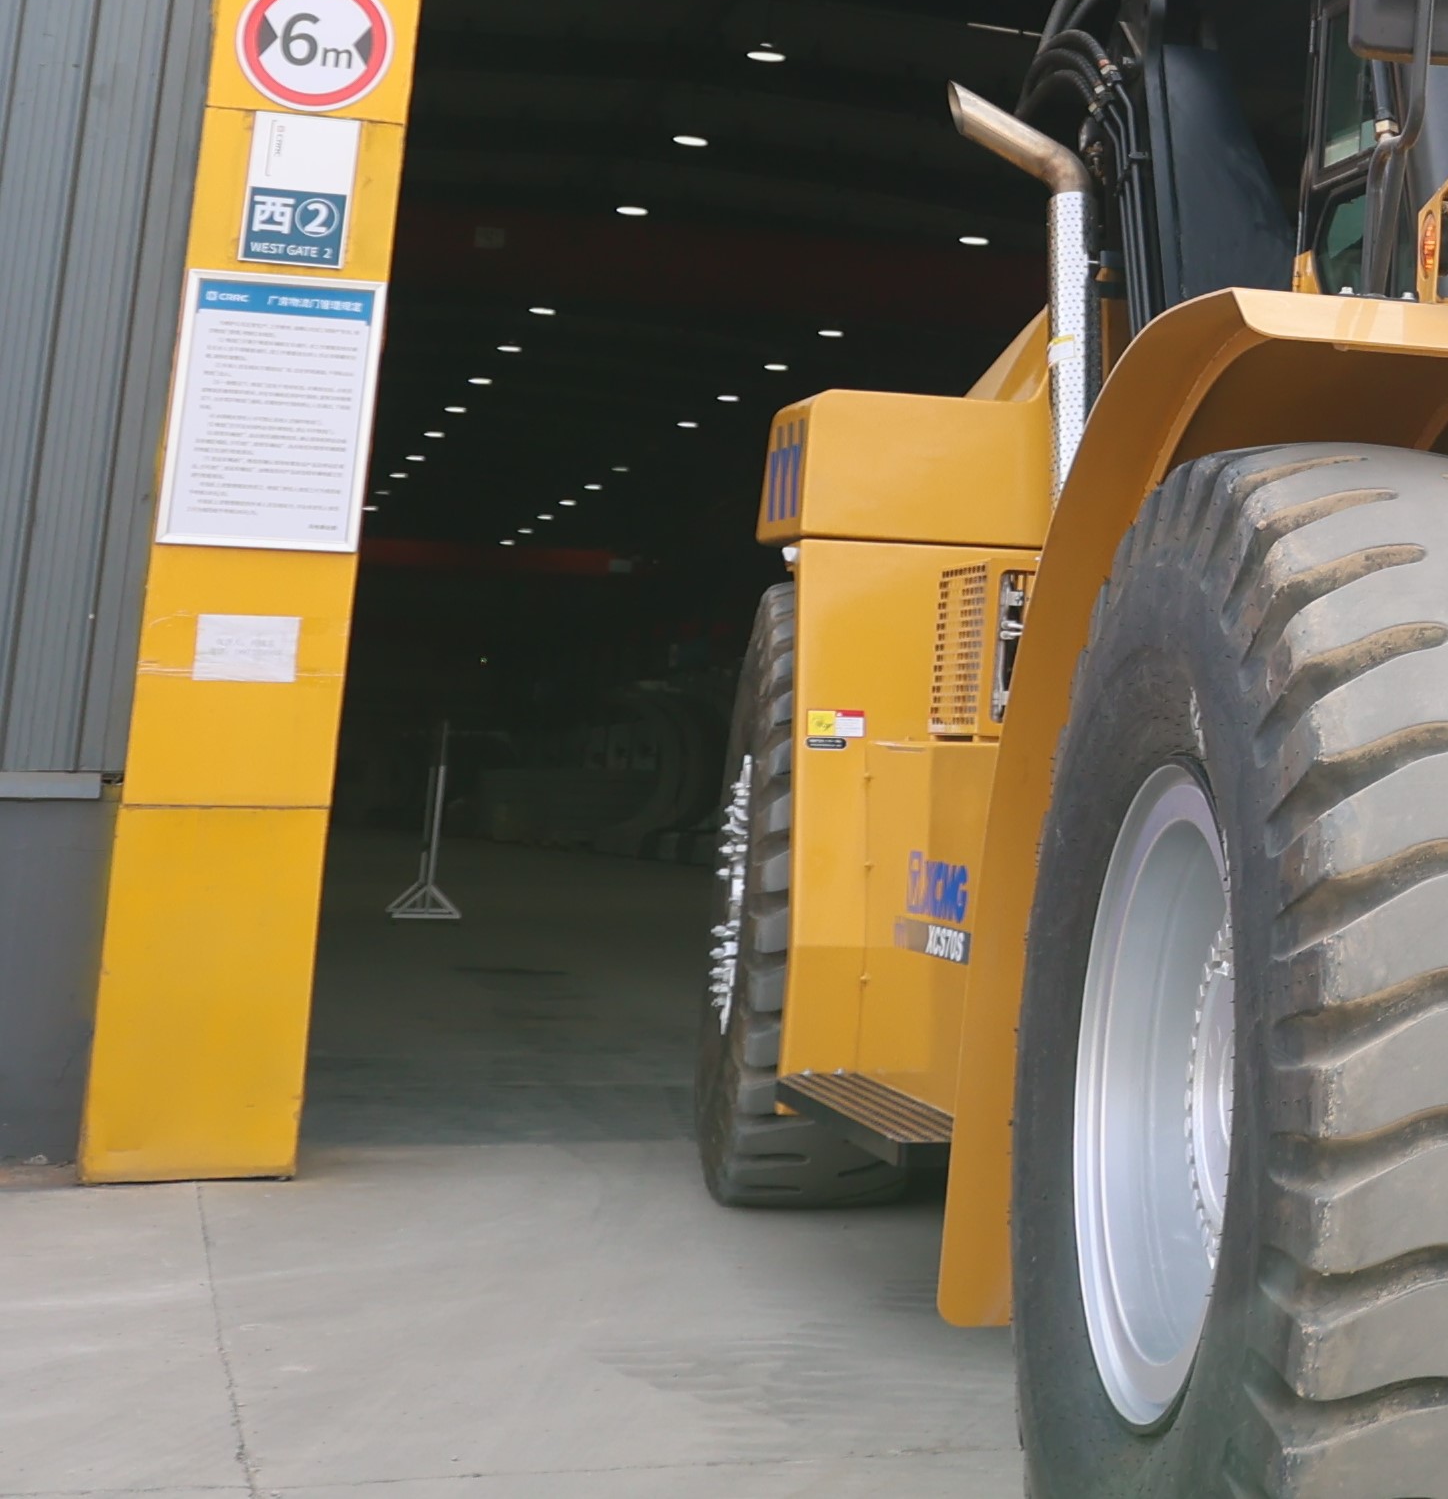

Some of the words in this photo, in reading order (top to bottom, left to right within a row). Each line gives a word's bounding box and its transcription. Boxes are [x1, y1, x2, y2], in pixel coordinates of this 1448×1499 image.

[280, 12, 353, 70] 6m
[250, 241, 287, 254] WEST
[287, 244, 319, 257] GATE
[322, 248, 333, 259] 2
[218, 292, 250, 303] CRRC
[923, 860, 969, 924] XCMG
[924, 924, 965, 962] XCS70S
